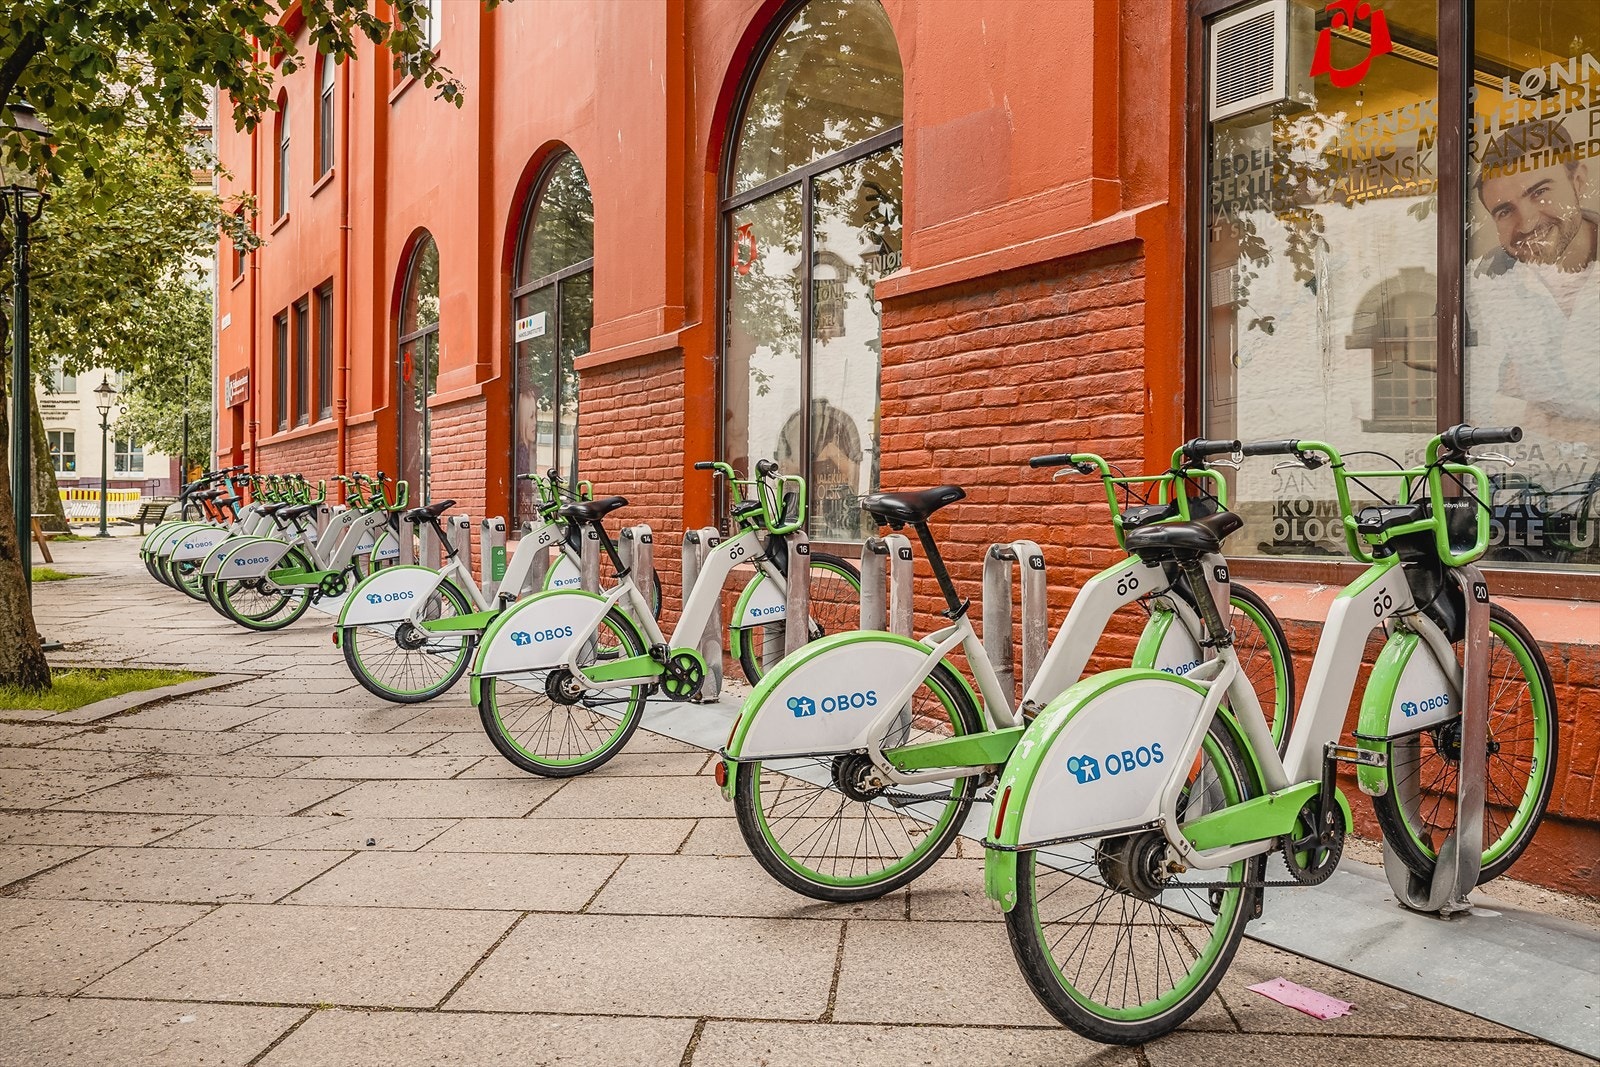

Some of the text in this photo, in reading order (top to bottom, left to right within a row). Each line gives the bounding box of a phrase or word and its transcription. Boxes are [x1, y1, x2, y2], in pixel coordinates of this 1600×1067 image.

[195, 540, 213, 548] OBOS
[643, 535, 651, 543] 14
[710, 538, 719, 546] 15
[799, 545, 808, 553] 16
[901, 549, 910, 558] 17
[247, 556, 269, 565] OBOS
[1032, 558, 1042, 568] 18
[1216, 568, 1227, 581] 19
[563, 576, 582, 585] OBOS
[384, 591, 414, 602] OBOS
[1475, 586, 1487, 600] 20
[763, 605, 786, 615] OBOS
[534, 626, 573, 642] OBOS
[821, 690, 878, 713] OBOS
[1419, 693, 1450, 713] OBOS
[1105, 742, 1164, 776] OBOS
